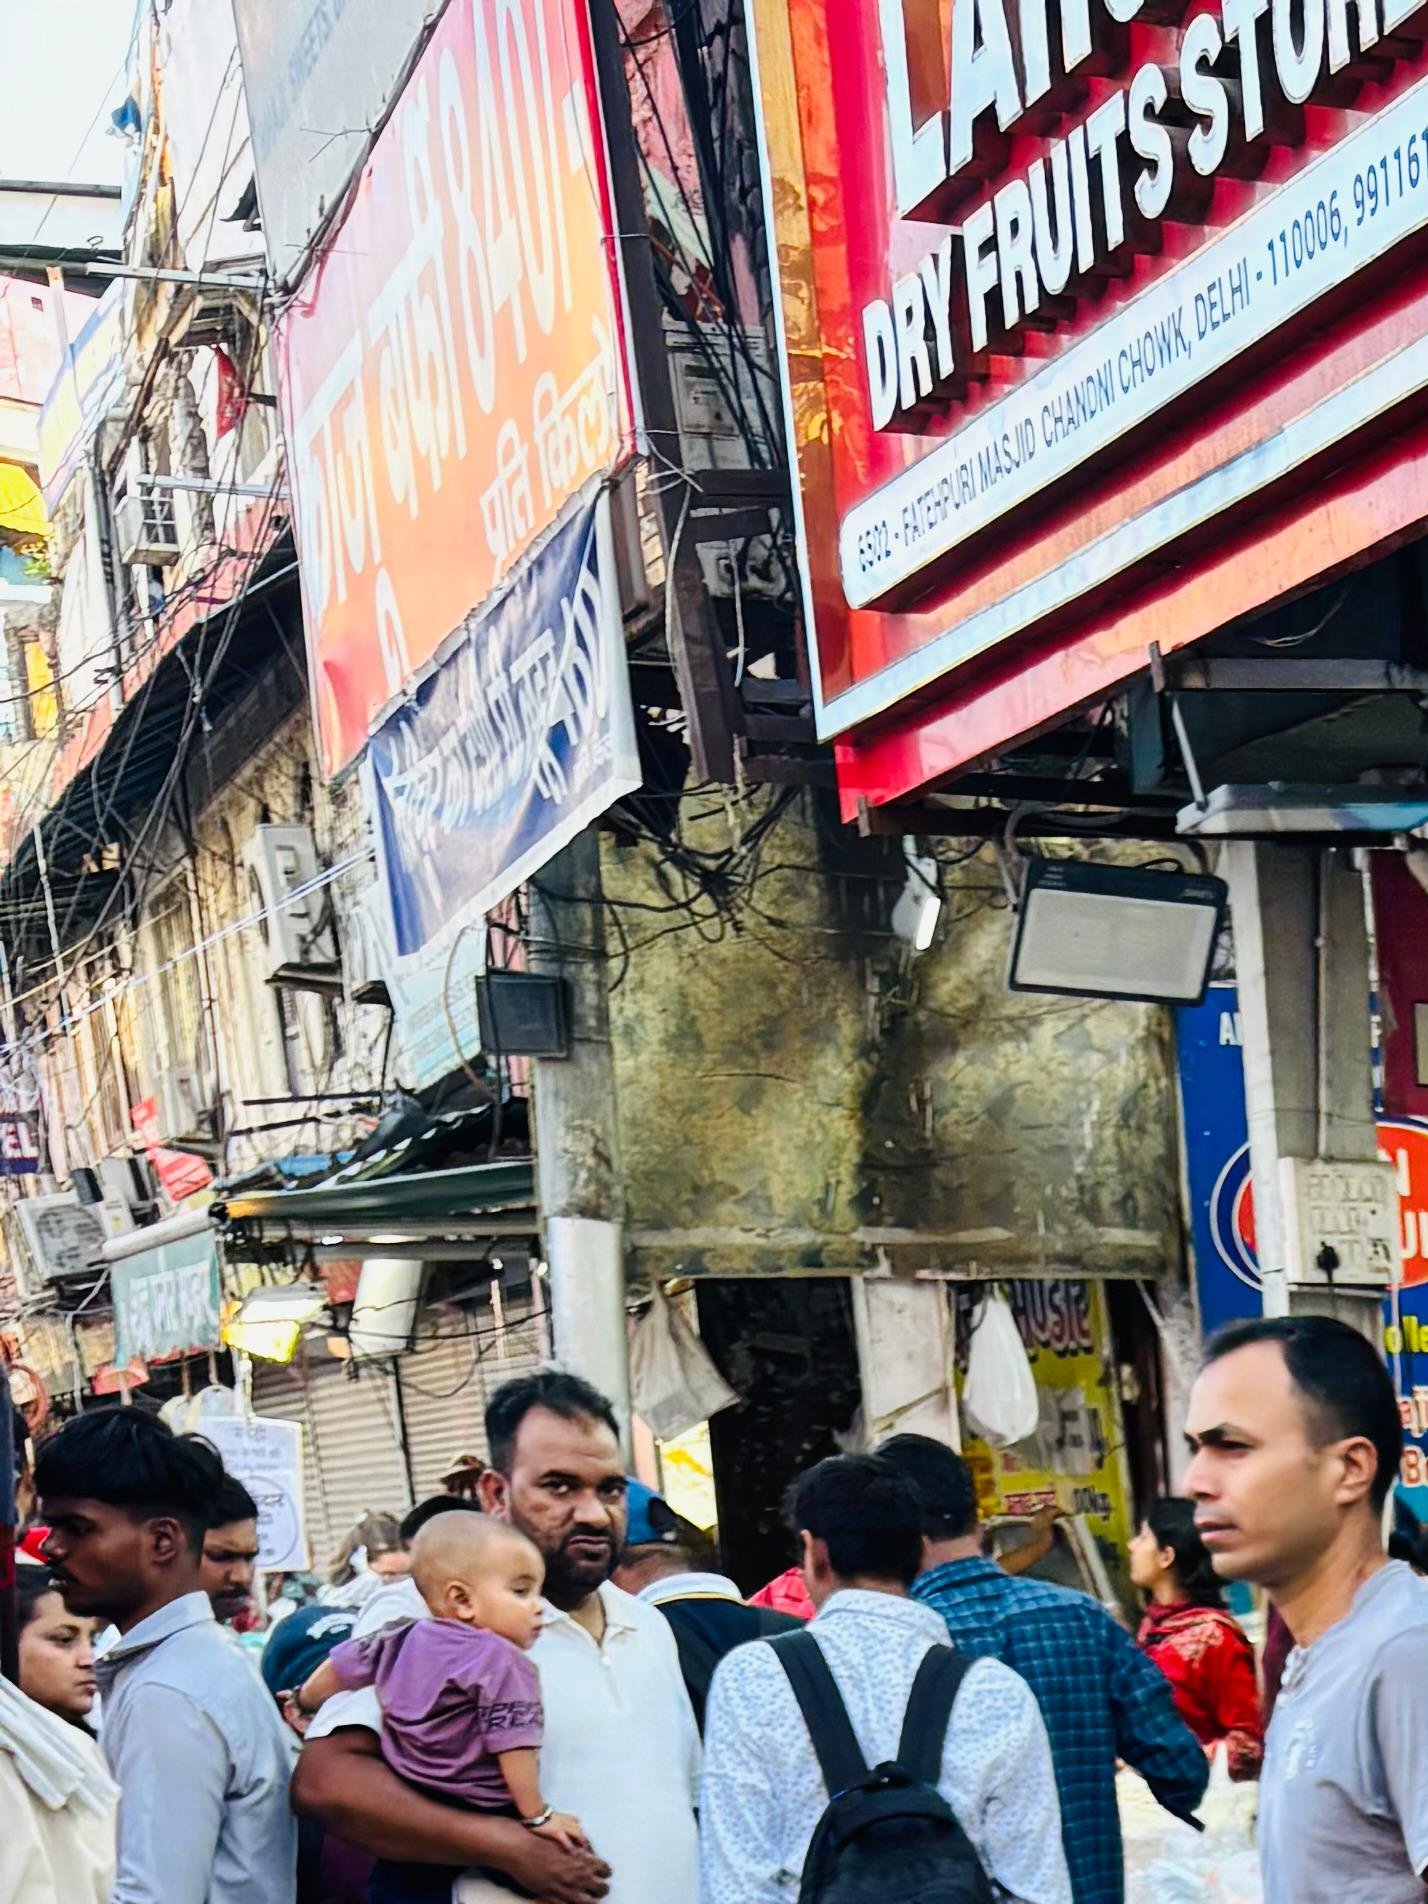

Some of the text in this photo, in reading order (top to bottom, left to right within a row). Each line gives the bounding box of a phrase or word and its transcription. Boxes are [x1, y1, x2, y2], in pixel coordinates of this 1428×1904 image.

[862, 240, 954, 432] DRY
[962, 62, 1176, 352] FRUITS
[901, 464, 977, 548] FATEHPURI
[980, 426, 1037, 503] MASJID
[1040, 358, 1115, 463] CHANDNI
[1117, 318, 1192, 418] CHOWK,
[1195, 277, 1250, 355] DELHI
[1268, 192, 1350, 290] 110006,
